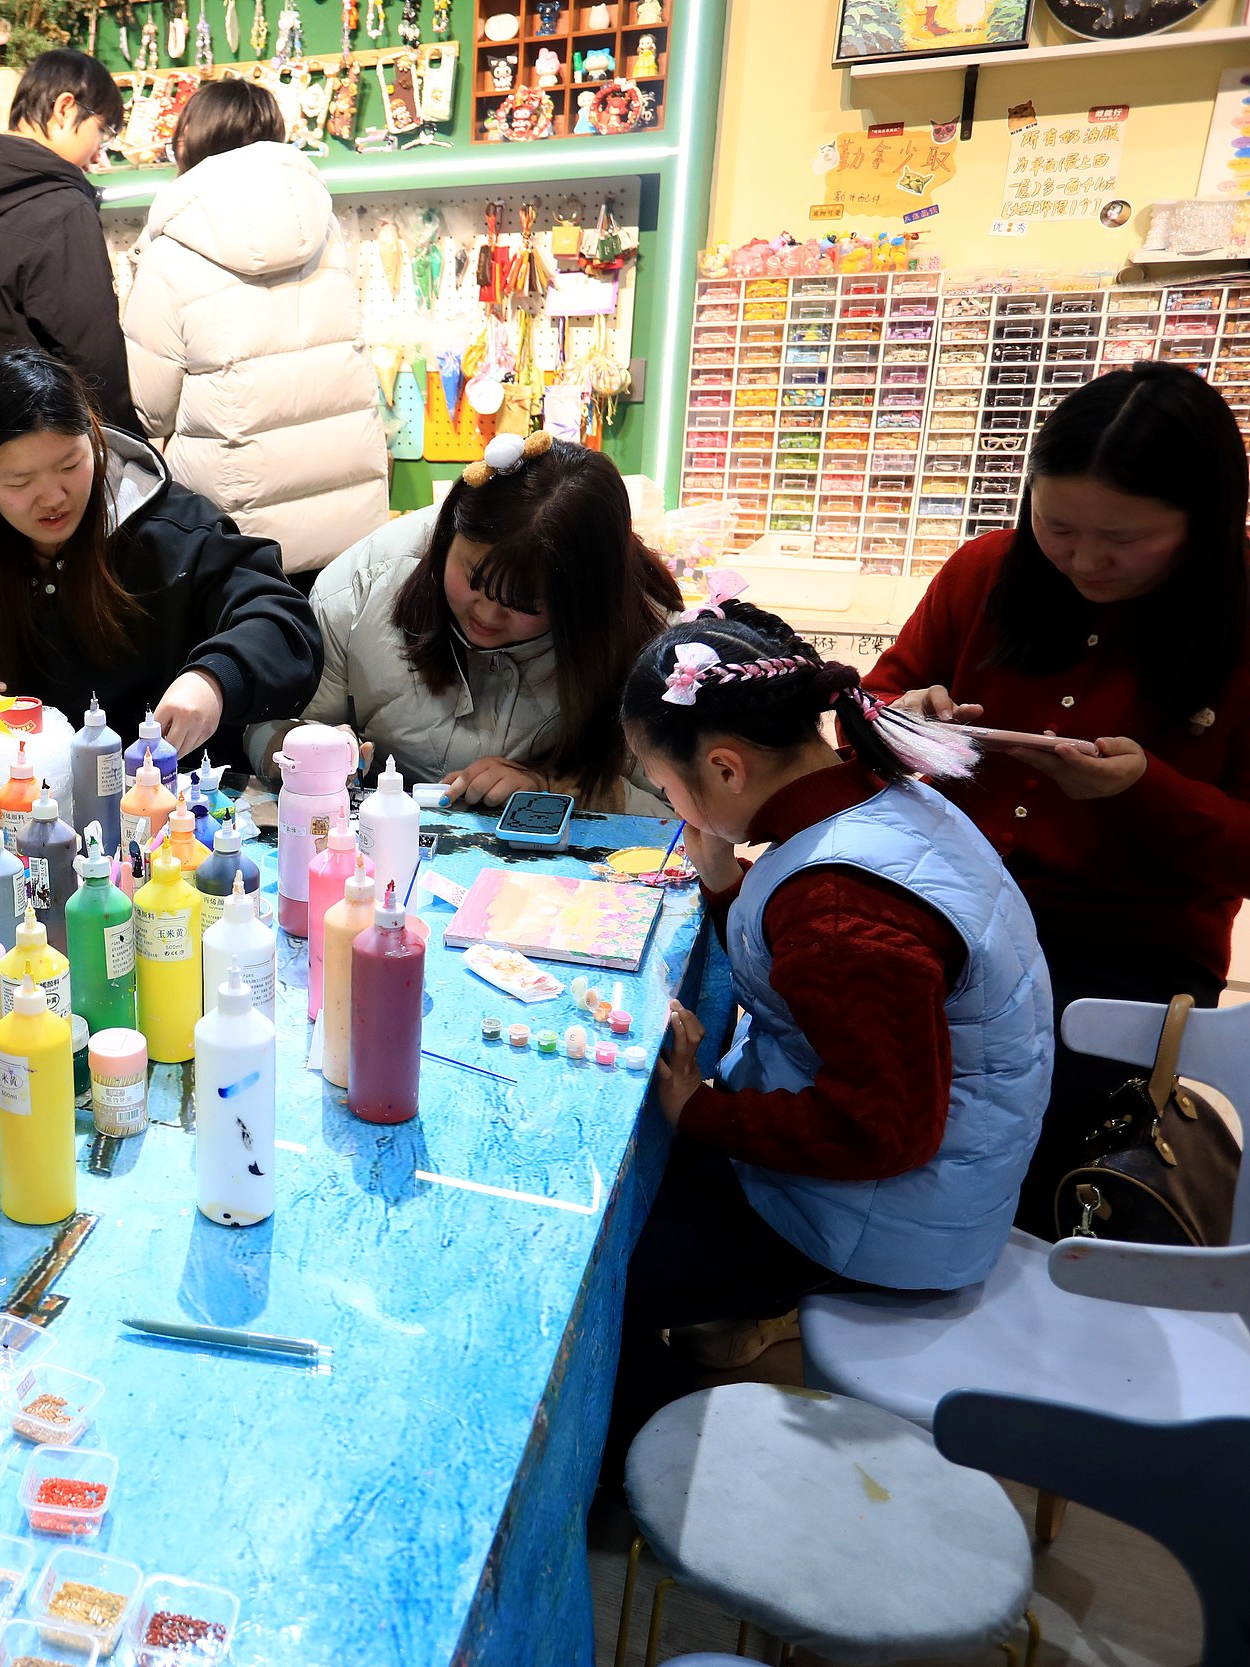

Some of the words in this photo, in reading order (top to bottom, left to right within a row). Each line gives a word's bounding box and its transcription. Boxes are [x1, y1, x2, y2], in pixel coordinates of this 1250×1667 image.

[836, 139, 951, 173] 勤拿少取
[157, 928, 184, 940] 玉米黄
